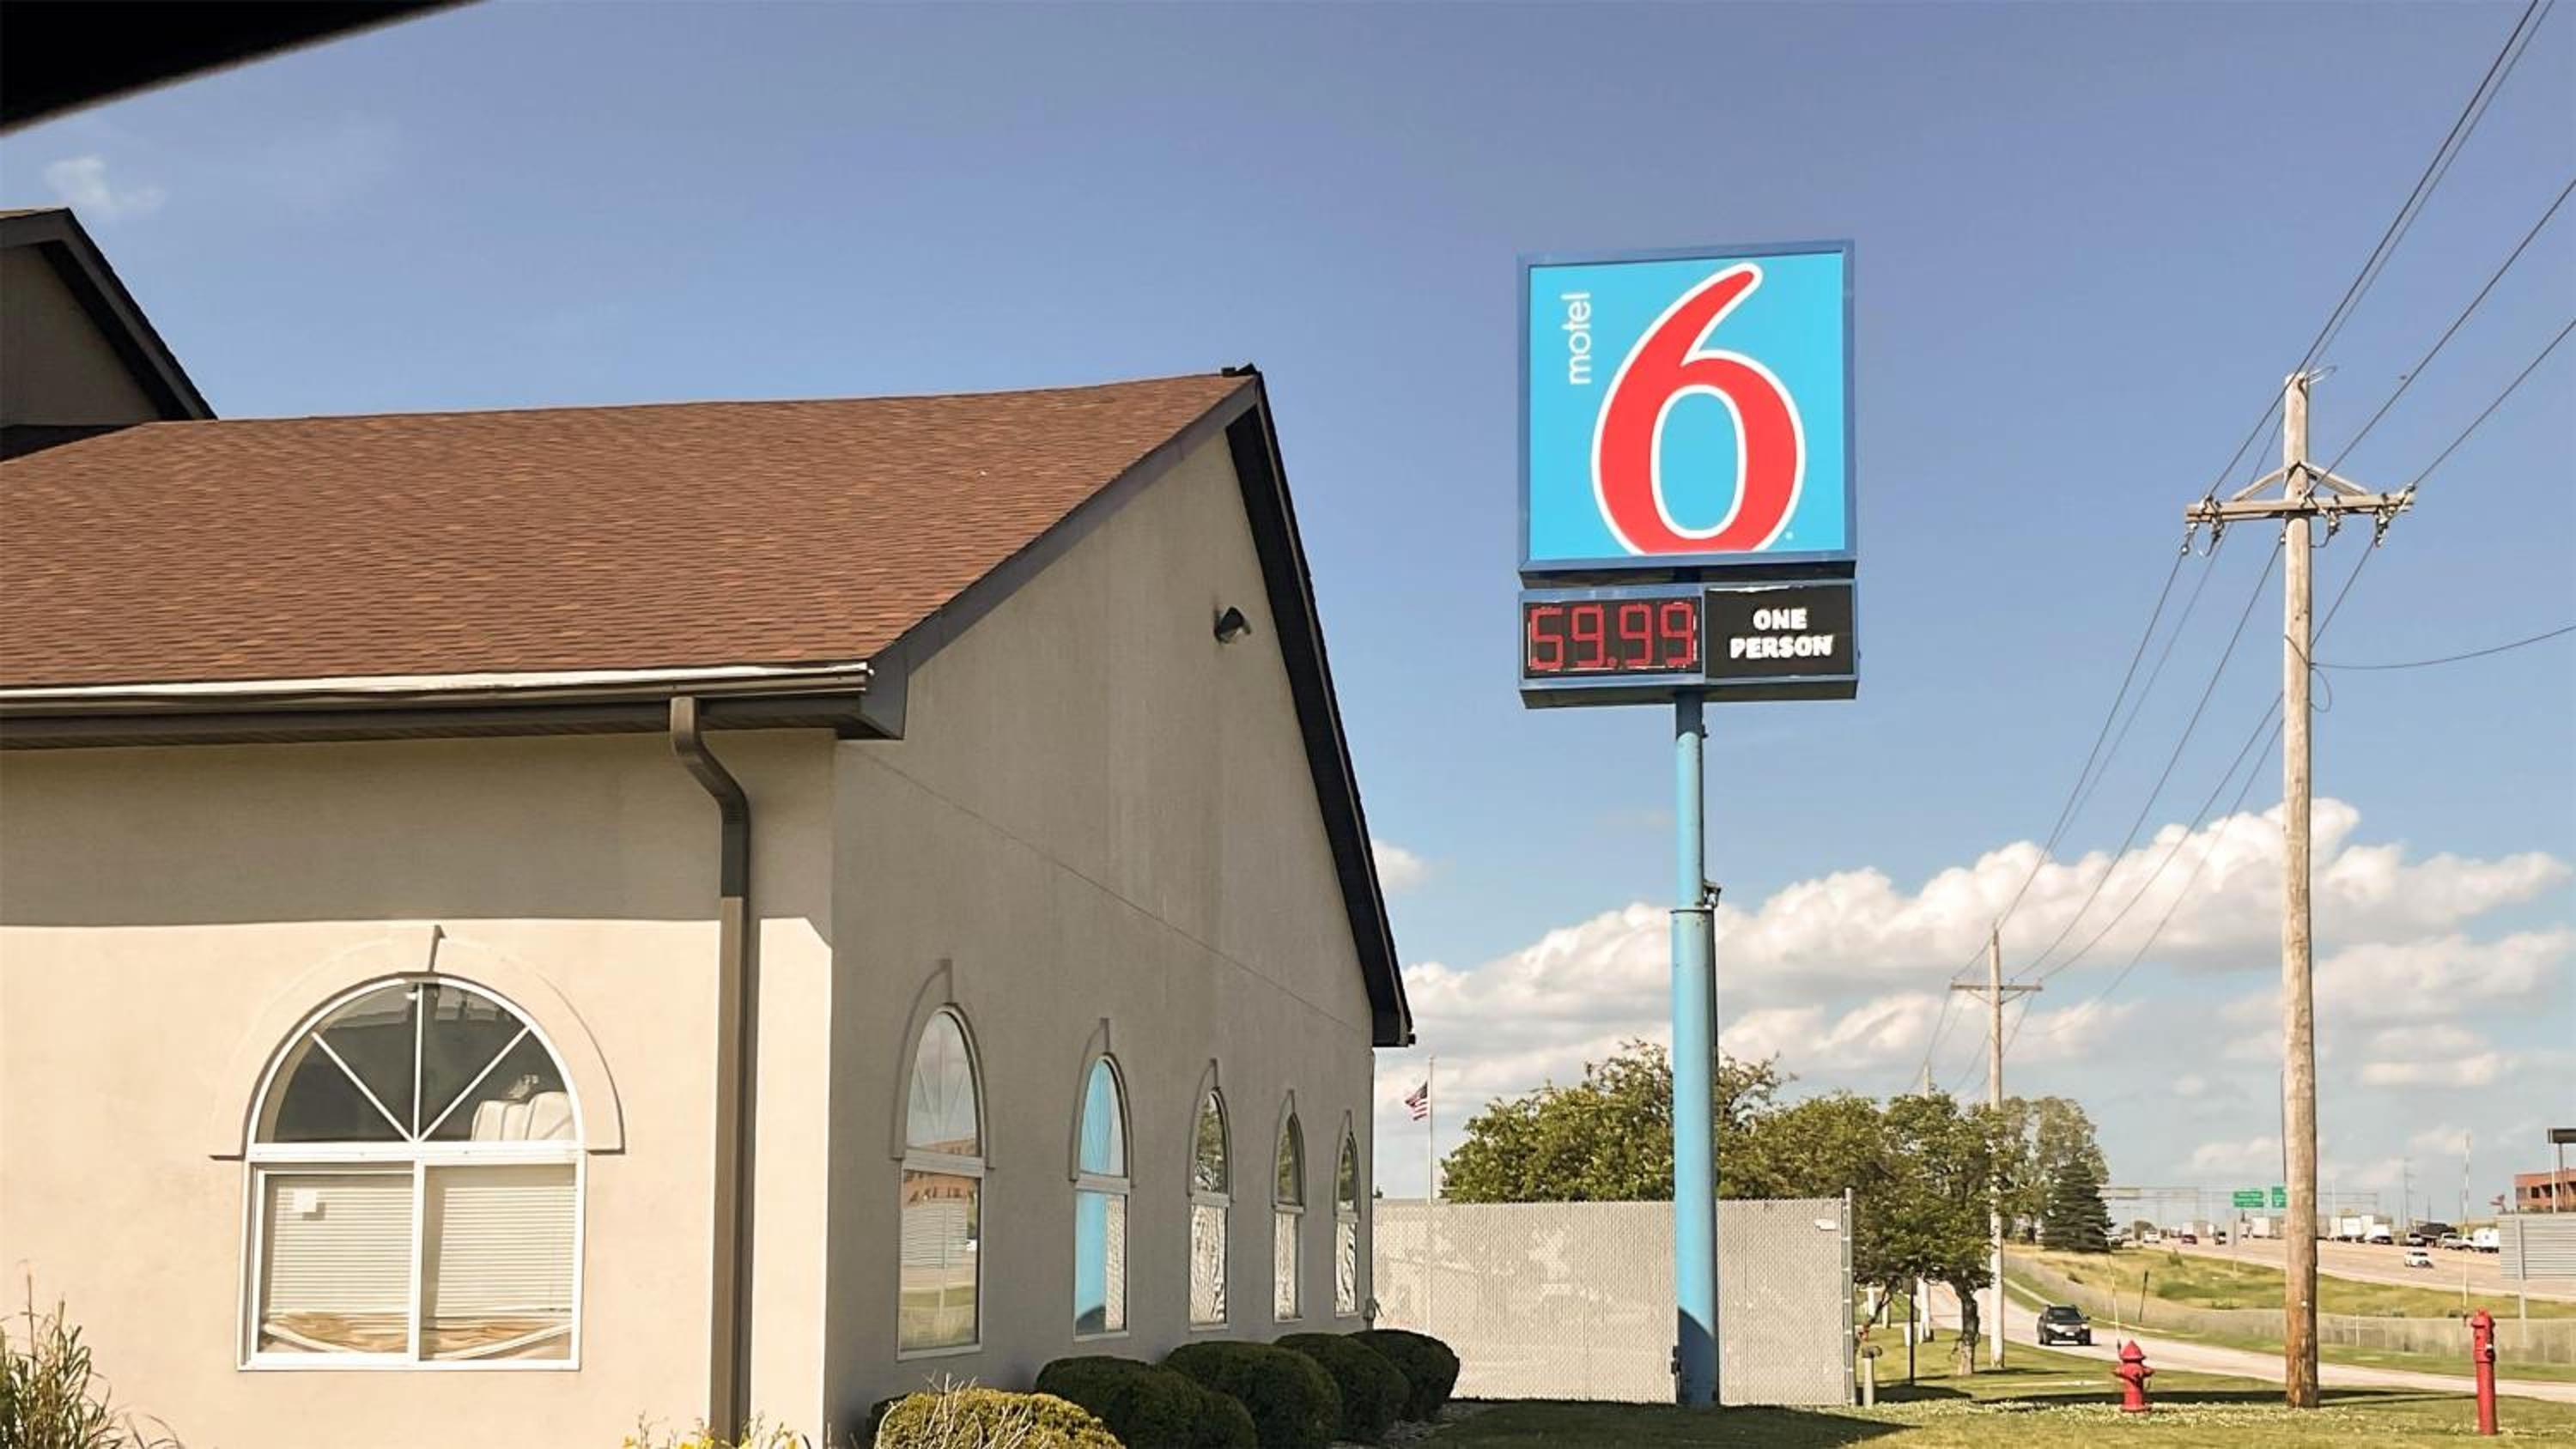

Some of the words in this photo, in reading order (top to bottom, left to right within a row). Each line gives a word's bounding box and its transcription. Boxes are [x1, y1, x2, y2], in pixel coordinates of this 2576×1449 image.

[1560, 292, 1591, 385] motel
[1591, 263, 1805, 555] 6
[1531, 602, 1694, 670] 59.99
[1729, 634, 1834, 659] PERSON
[1753, 607, 1807, 631] ONE
